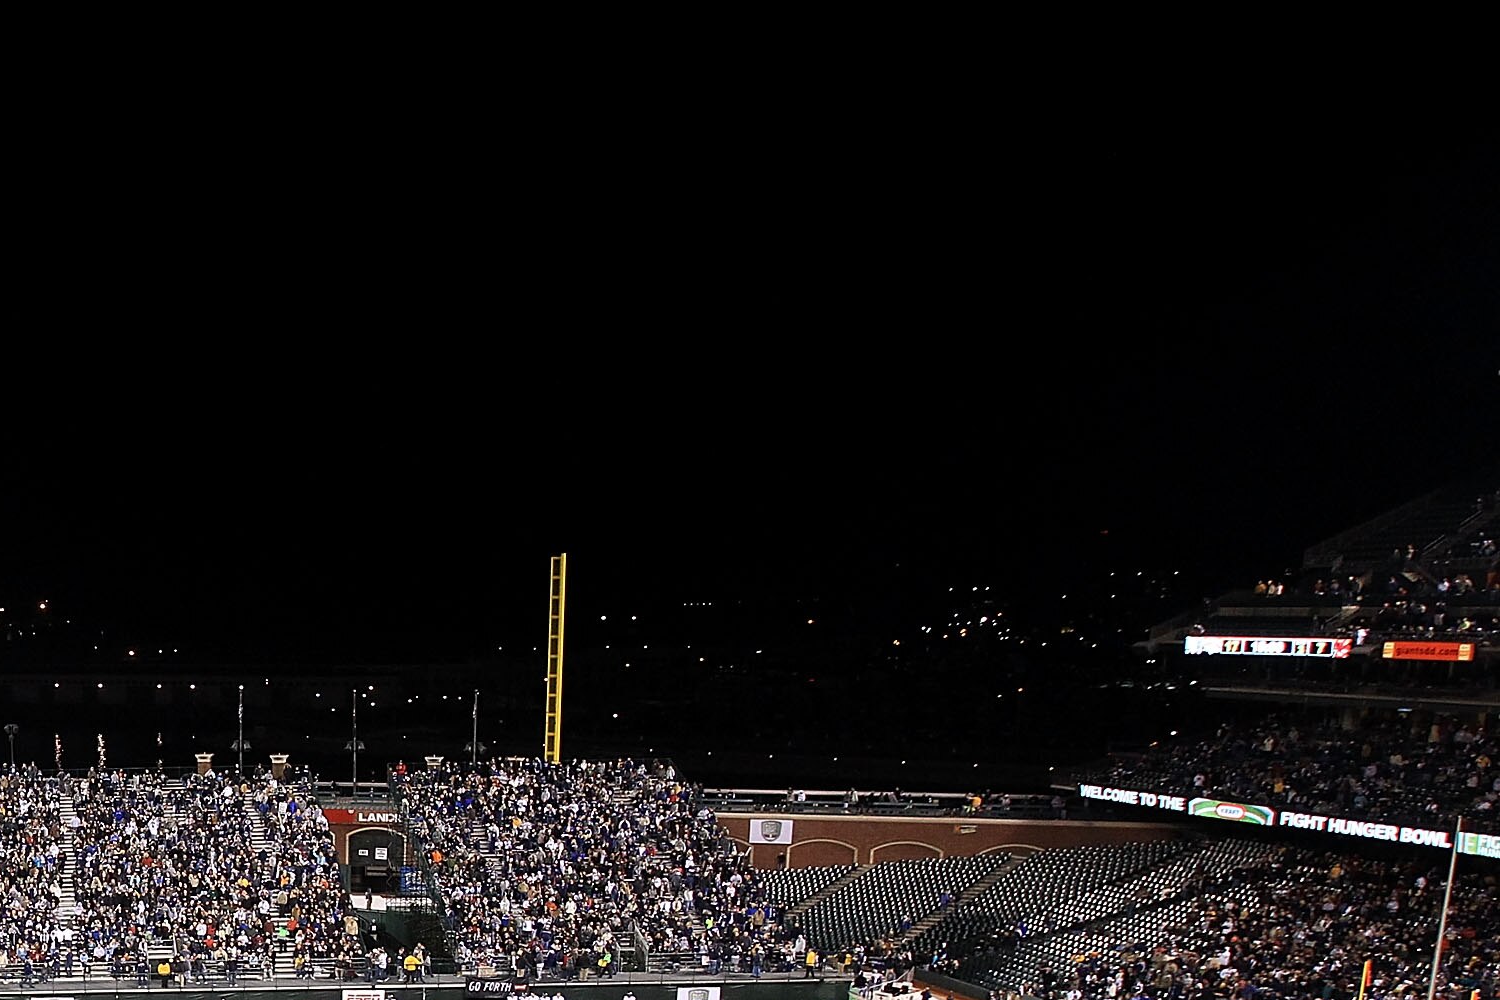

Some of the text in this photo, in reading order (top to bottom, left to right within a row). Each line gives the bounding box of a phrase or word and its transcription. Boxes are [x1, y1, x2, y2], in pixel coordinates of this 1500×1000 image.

[1080, 784, 1186, 811] WELCOME TO THE
[1279, 811, 1453, 848] FIGHT HUNGER BOWL
[468, 982, 482, 992] GO
[483, 981, 512, 992] FORTH
